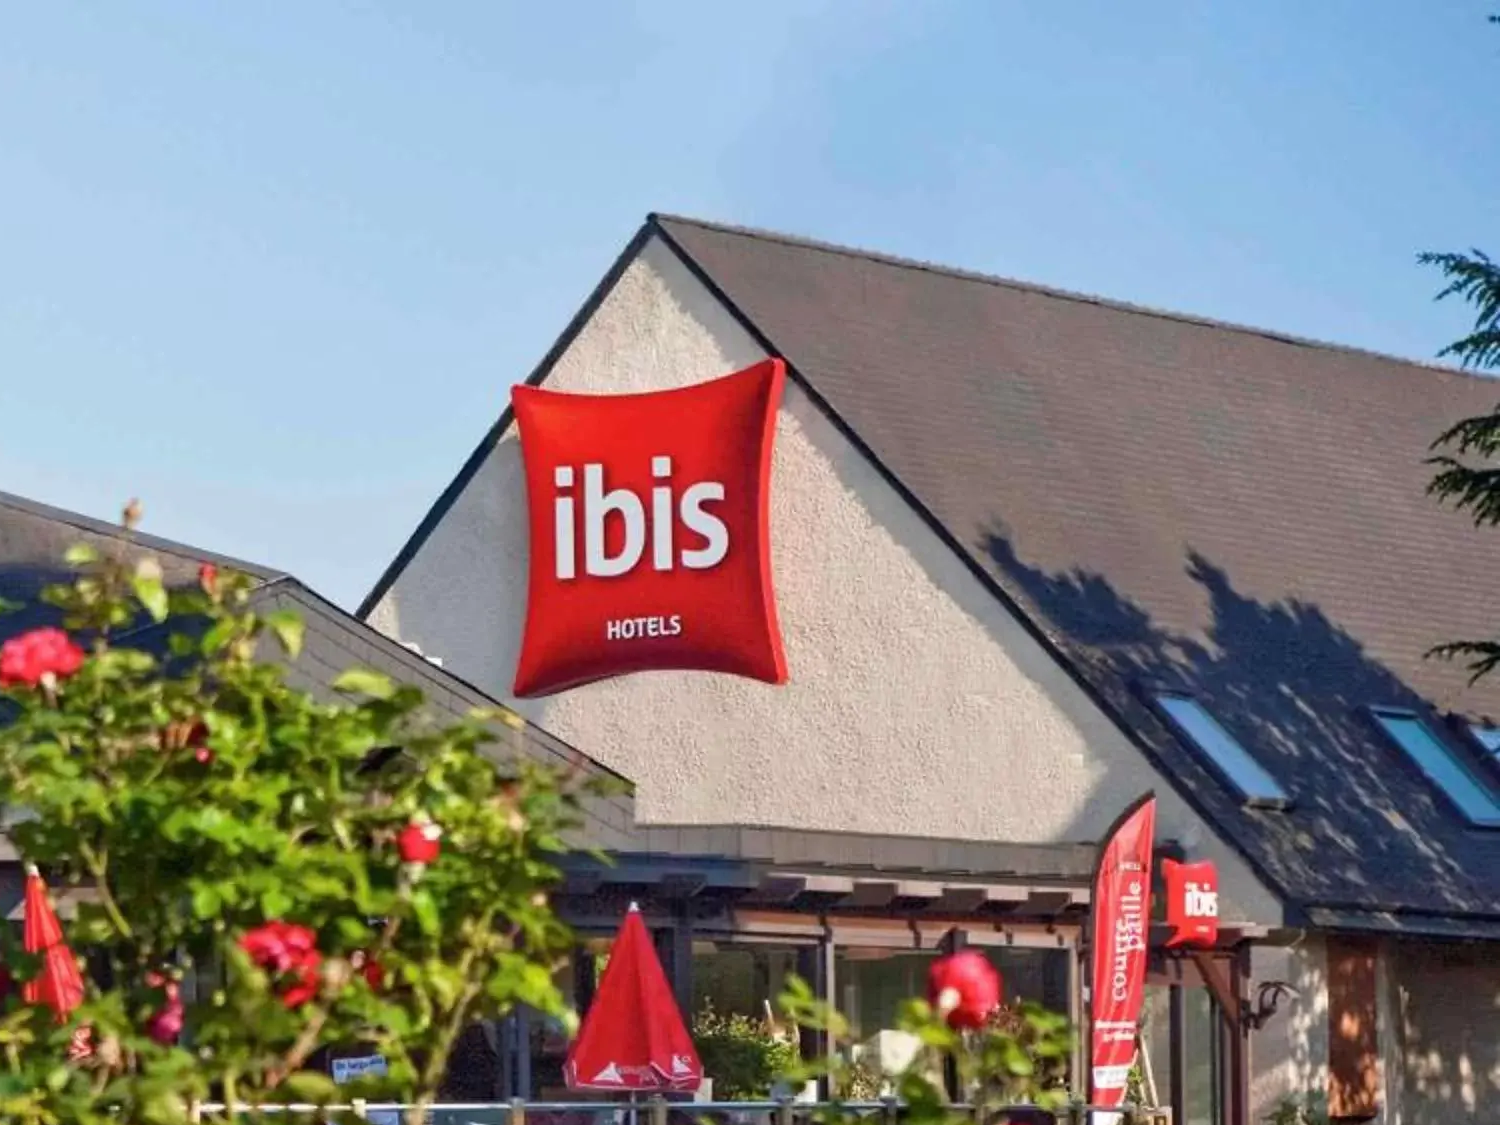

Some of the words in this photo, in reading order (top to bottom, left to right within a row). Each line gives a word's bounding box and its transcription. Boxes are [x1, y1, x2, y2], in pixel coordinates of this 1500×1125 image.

[554, 455, 729, 579] ibis
[606, 615, 682, 639] HOTELS
[1184, 881, 1218, 917] ibis
